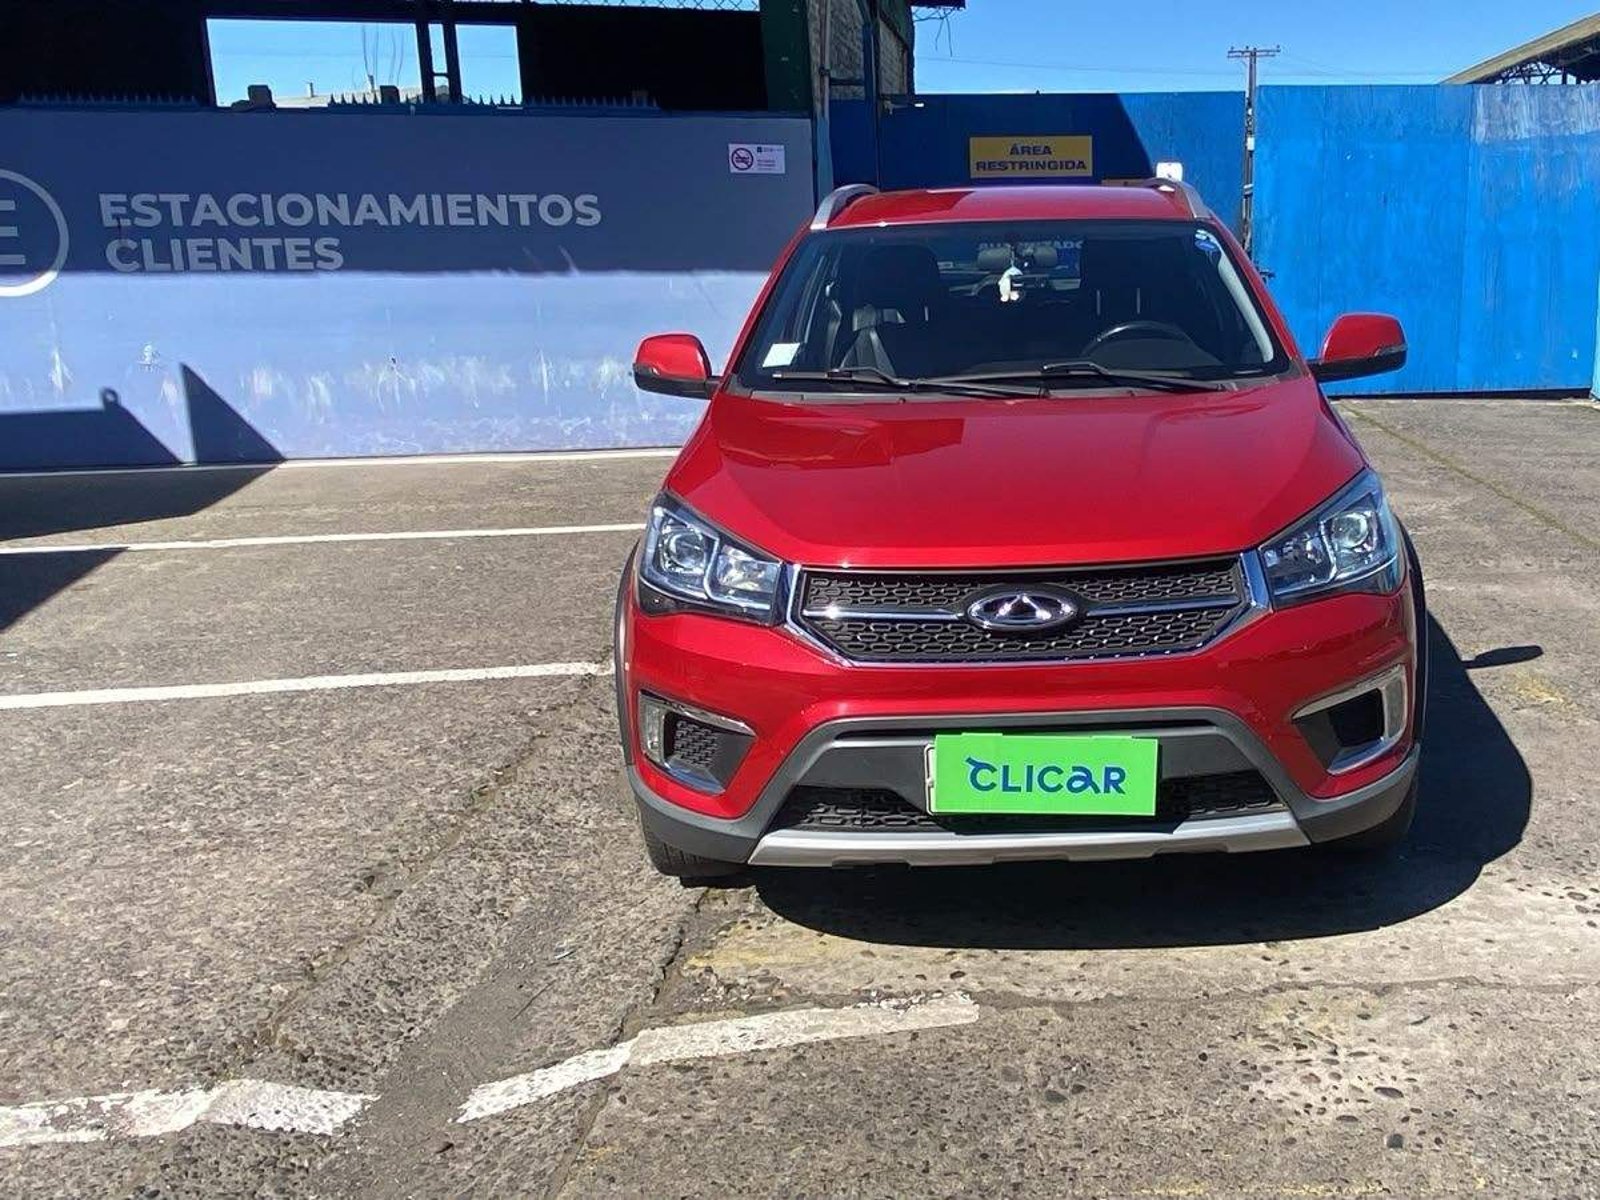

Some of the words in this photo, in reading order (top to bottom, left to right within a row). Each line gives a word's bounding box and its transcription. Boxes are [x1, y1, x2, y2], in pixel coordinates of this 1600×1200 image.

[1009, 143, 1053, 156] ÁREA
[976, 160, 1087, 171] RESTRINGIDA
[99, 193, 602, 228] ESTACIONAMIENTOS
[105, 237, 345, 272] CLIENTES
